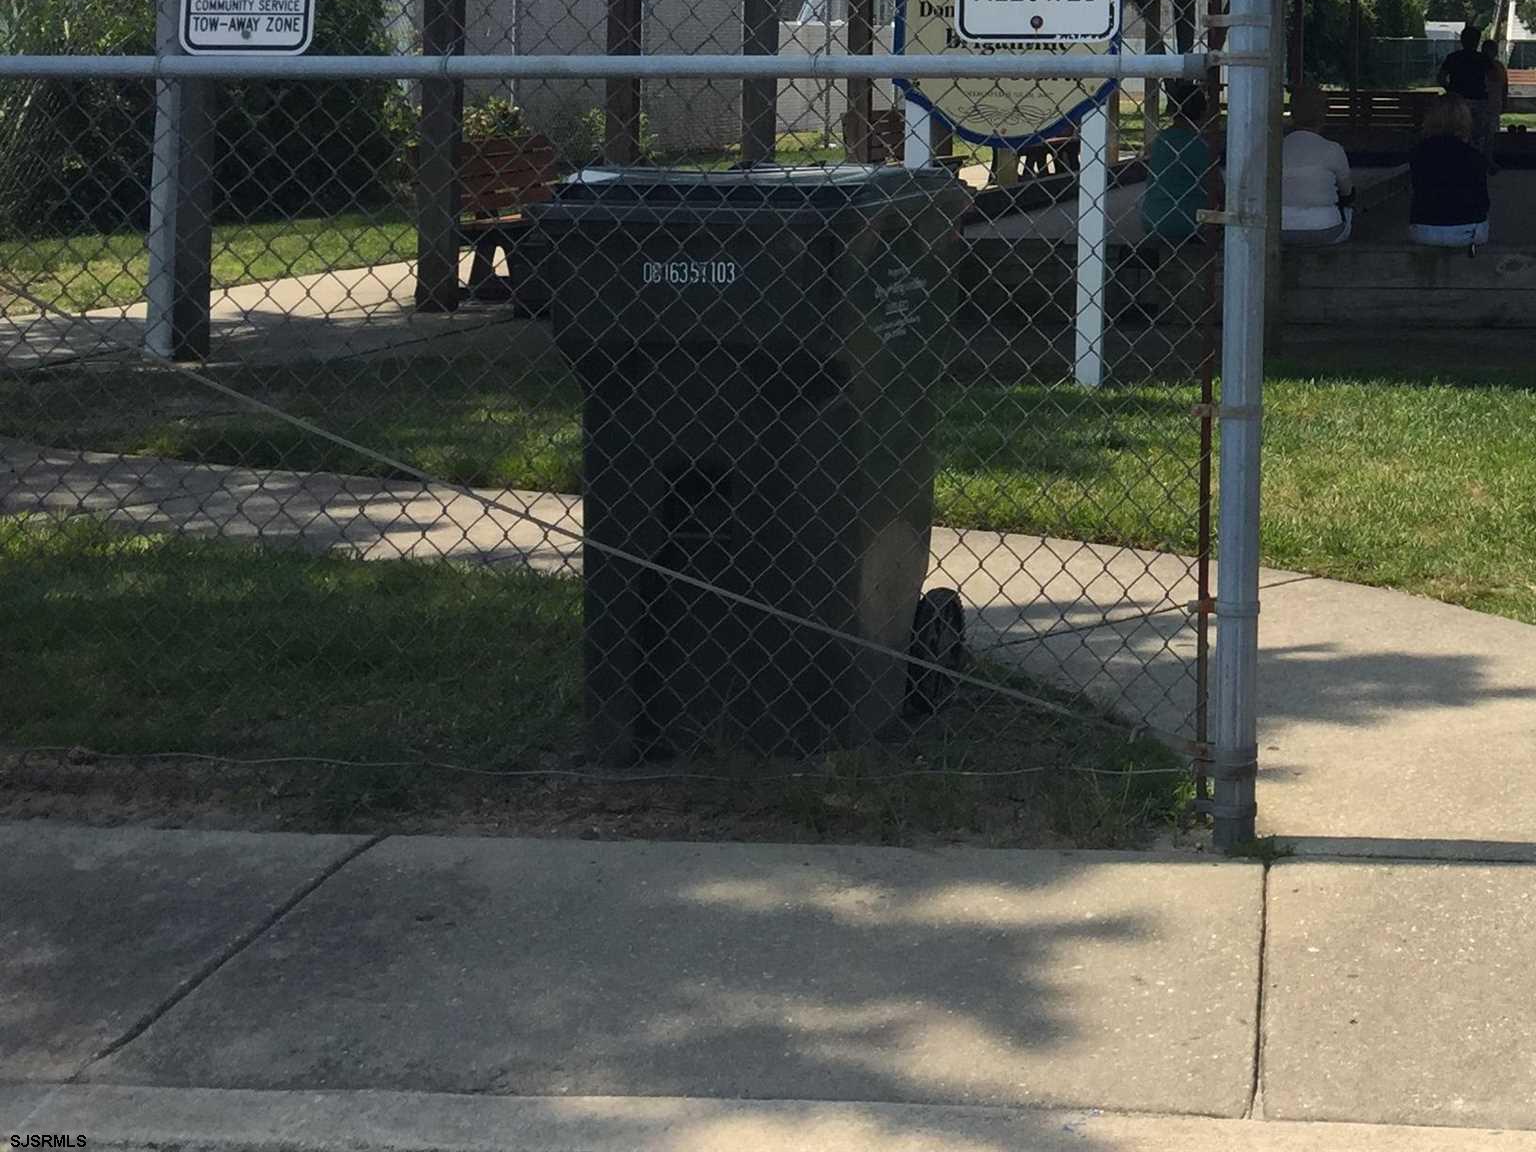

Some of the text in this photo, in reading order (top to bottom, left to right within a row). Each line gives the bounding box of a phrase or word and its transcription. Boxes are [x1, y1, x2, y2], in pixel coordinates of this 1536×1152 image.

[195, 0, 300, 12] COMMUNITY SERVICE
[193, 16, 300, 32] TOW-AWAY ZONE
